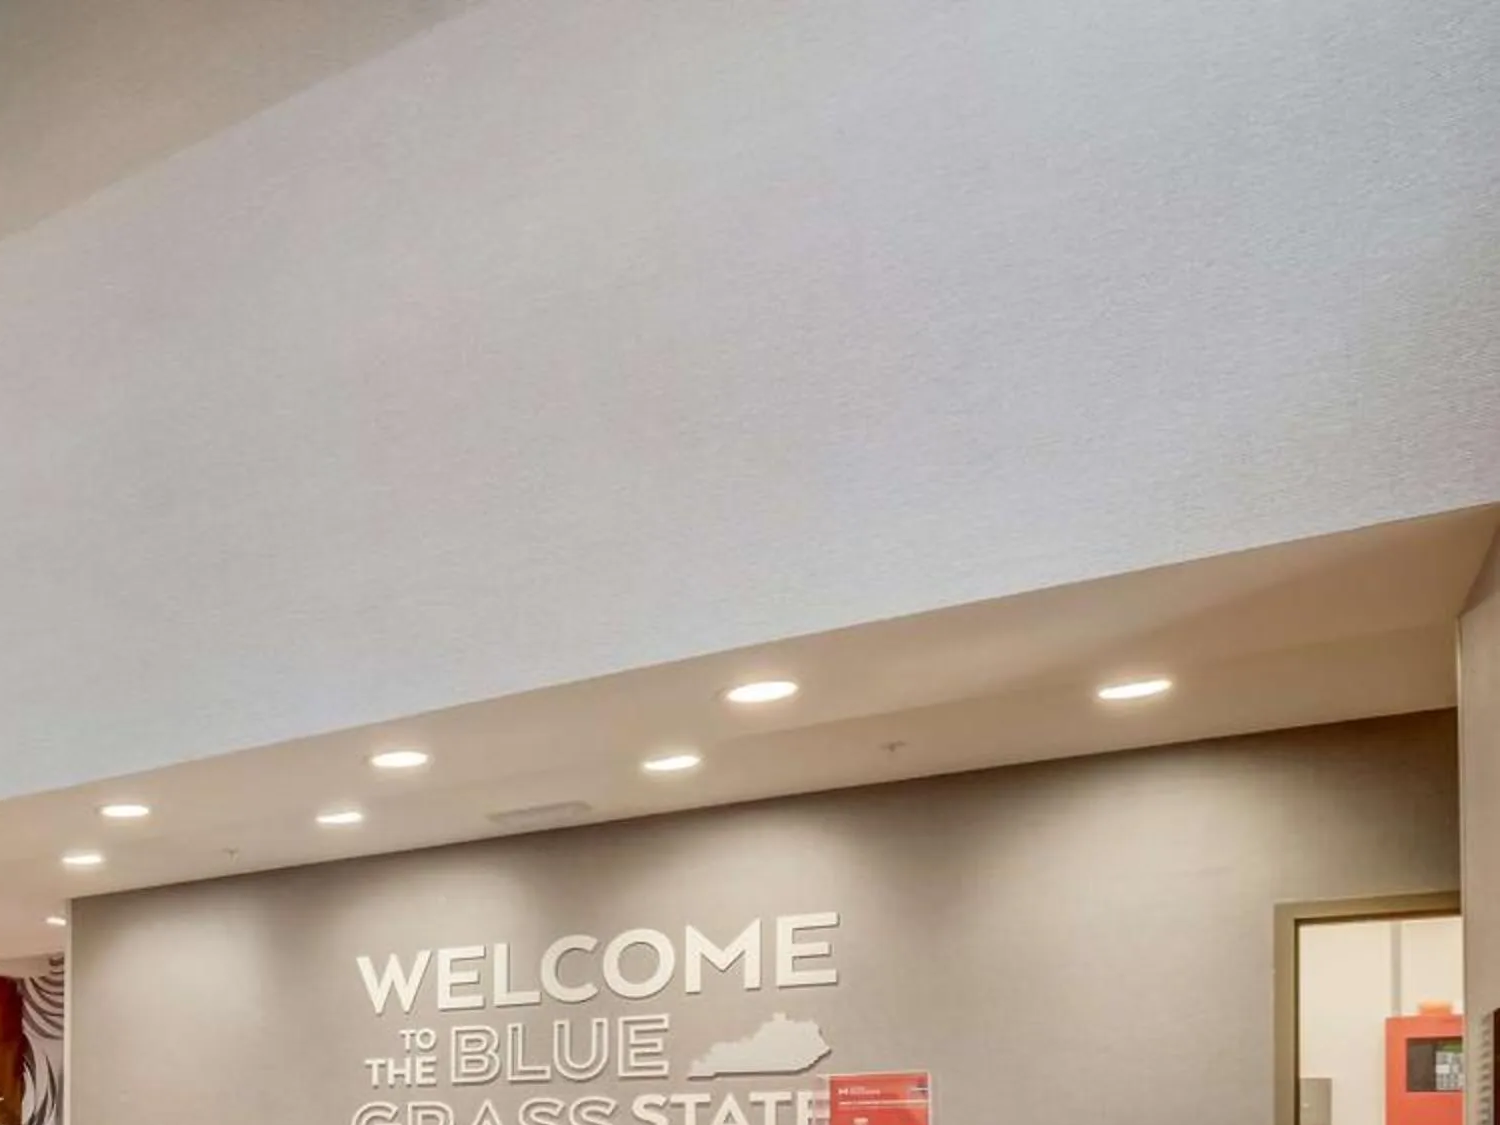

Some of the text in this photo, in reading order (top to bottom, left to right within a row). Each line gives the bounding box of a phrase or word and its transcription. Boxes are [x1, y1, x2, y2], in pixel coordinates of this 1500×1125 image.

[356, 912, 839, 1015] WELCOME
[364, 1013, 670, 1088] THE BLUE
[400, 1028, 437, 1052] TO
